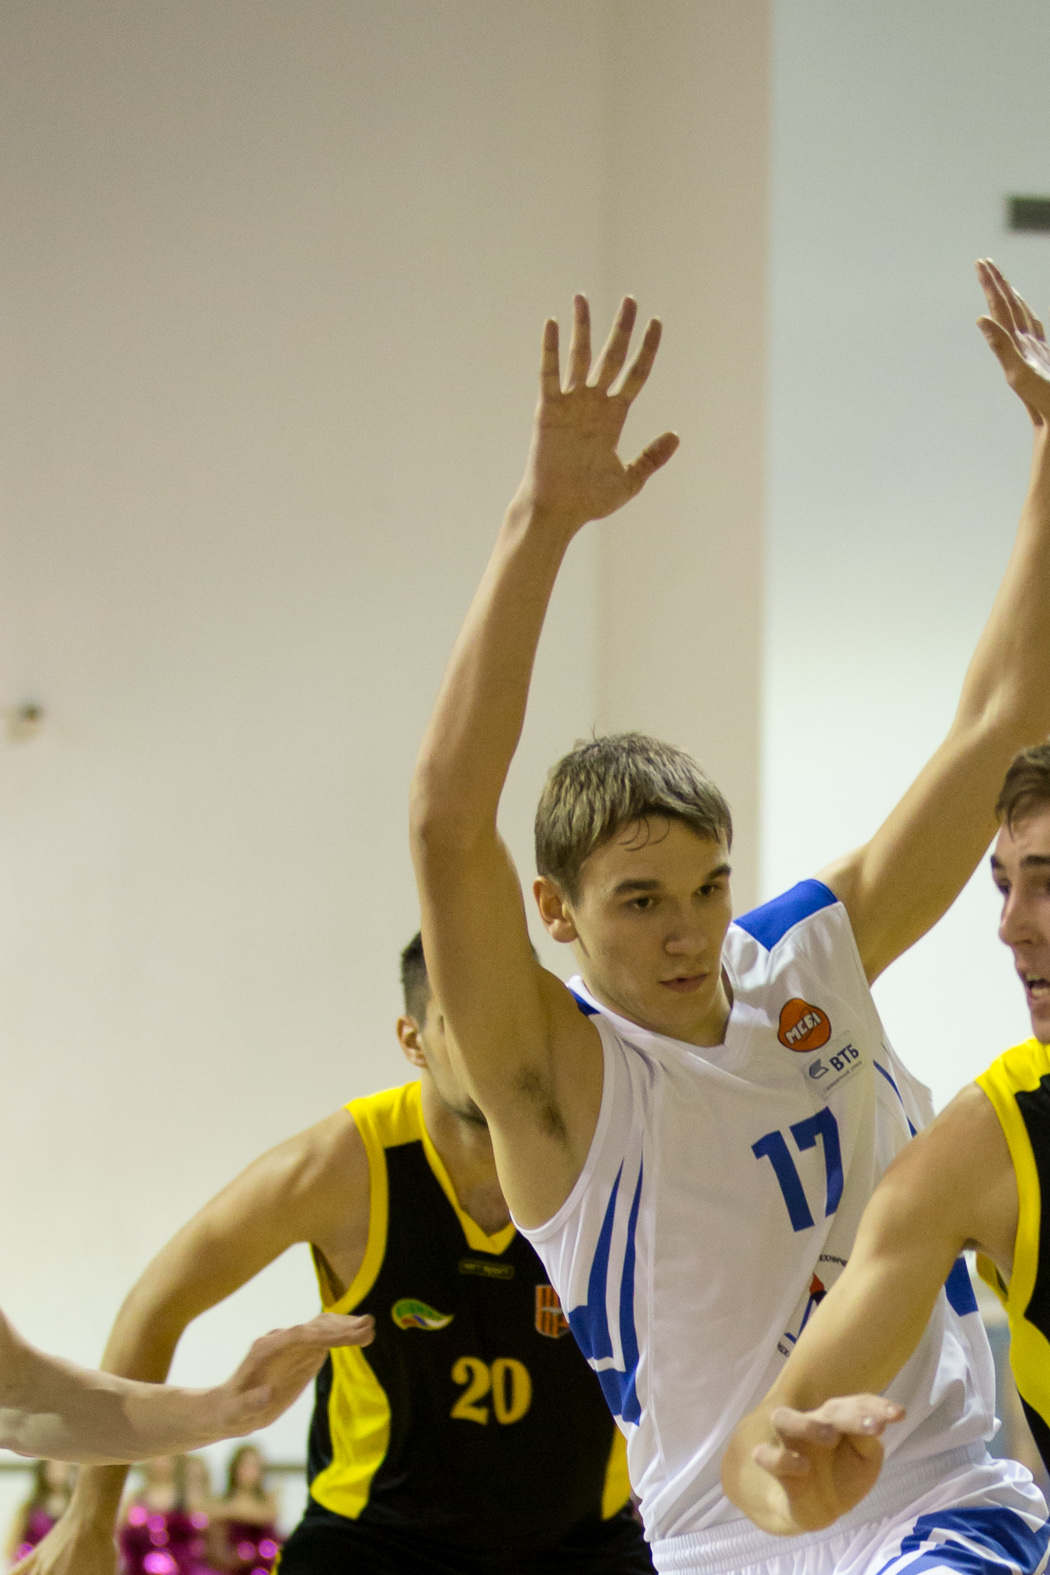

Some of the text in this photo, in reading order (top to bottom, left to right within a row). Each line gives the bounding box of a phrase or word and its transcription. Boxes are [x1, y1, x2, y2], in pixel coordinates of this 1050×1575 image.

[829, 1044, 860, 1072] ВТБ
[751, 1106, 844, 1232] 17
[449, 1355, 533, 1426] 20
